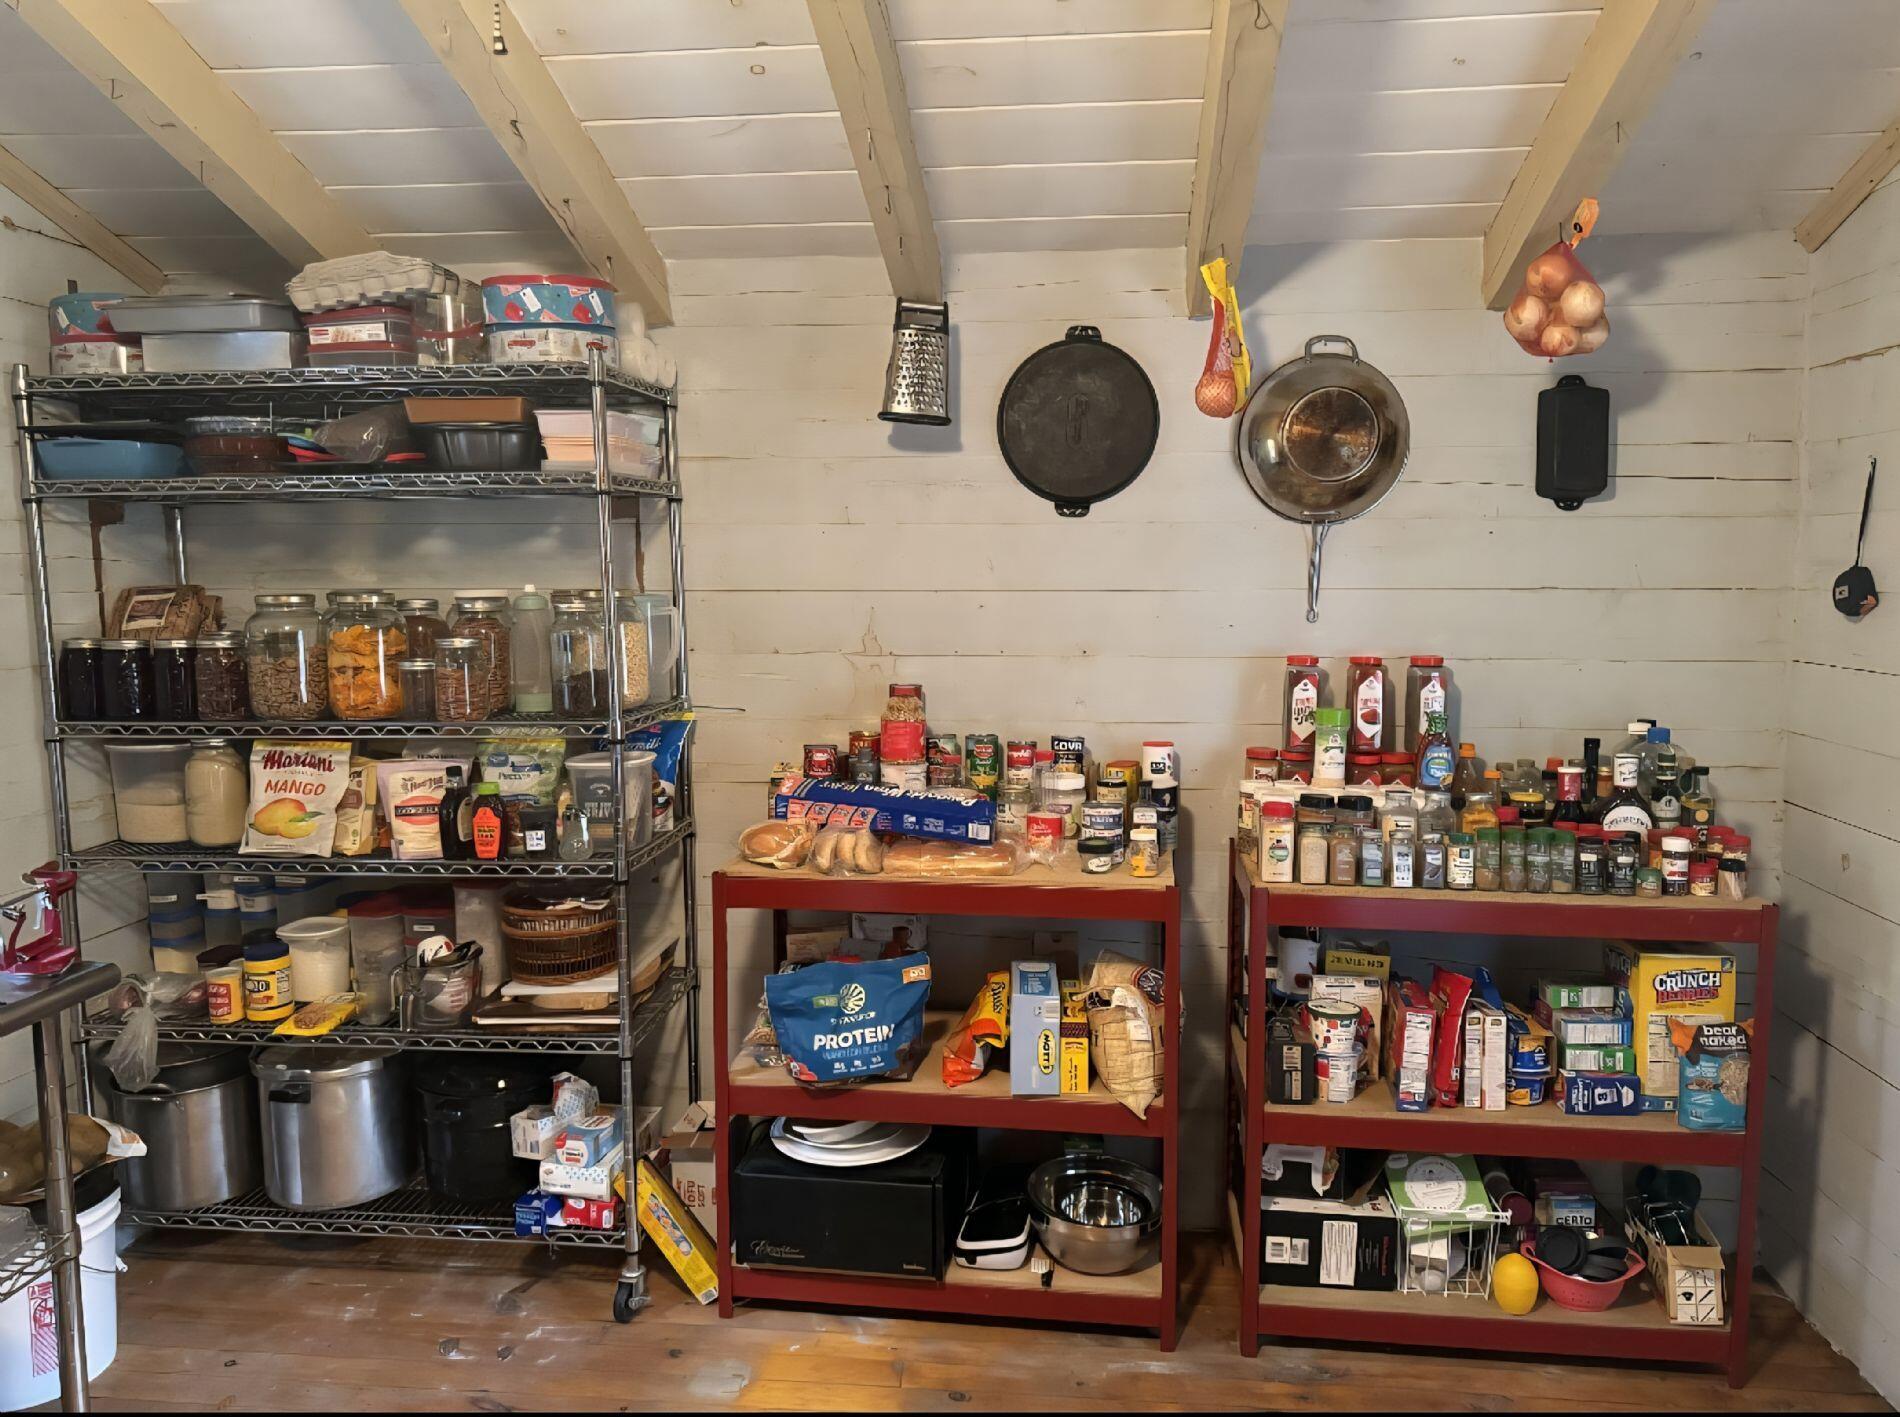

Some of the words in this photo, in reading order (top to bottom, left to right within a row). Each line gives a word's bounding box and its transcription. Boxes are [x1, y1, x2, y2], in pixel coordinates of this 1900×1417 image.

[262, 749, 336, 773] Mariani
[264, 779, 327, 796] MANGO
[1653, 972, 1722, 992] CRUNCH
[813, 1024, 896, 1051] PROTEIN
[1703, 1025, 1738, 1036] bear
[1699, 1034, 1747, 1047] naked
[1556, 1215, 1593, 1226] CERTO
